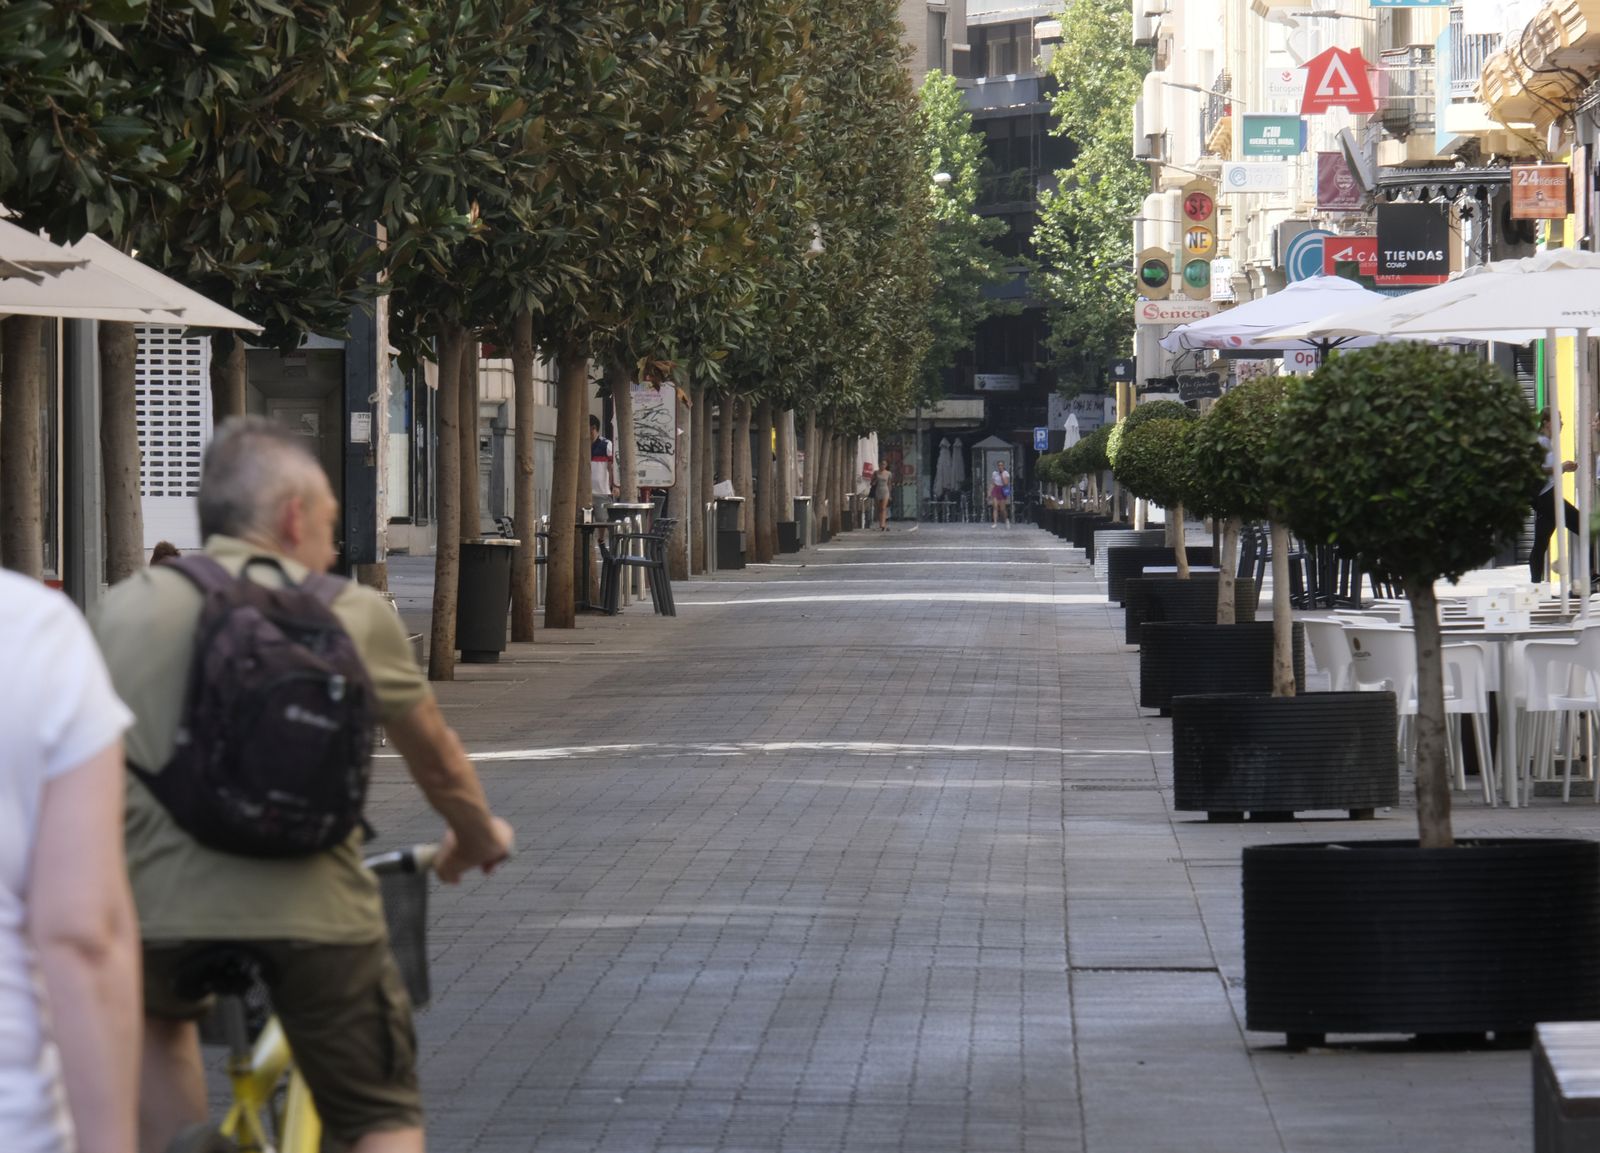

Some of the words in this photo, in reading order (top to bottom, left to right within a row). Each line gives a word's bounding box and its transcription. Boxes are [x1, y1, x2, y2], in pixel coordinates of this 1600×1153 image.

[1517, 170, 1539, 186] 24
[1539, 176, 1564, 186] horas
[1189, 231, 1208, 249] NE
[1384, 250, 1444, 261] TIENDAS
[1143, 303, 1210, 320] Seneca
[1036, 430, 1046, 442] P
